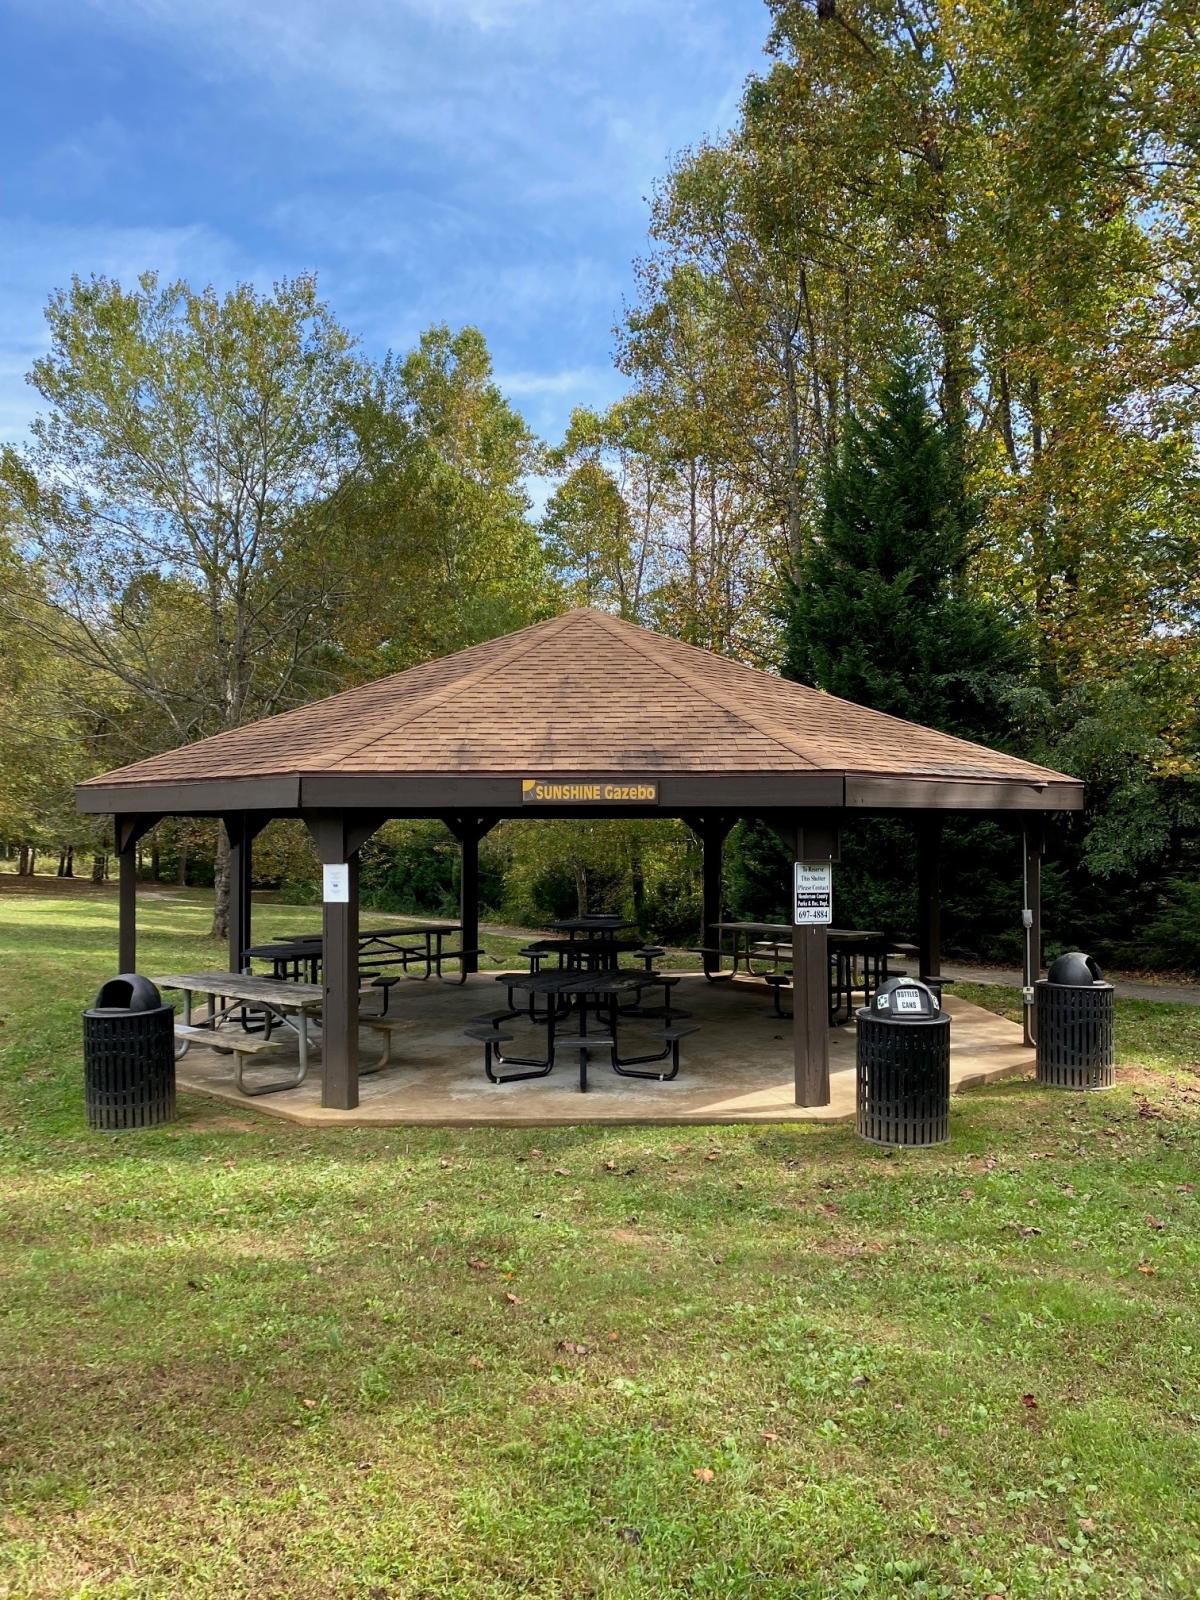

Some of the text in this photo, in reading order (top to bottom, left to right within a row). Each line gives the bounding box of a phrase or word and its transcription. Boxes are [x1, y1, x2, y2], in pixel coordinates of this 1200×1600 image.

[536, 785, 655, 800] SUNSHINE Gazebo
[798, 910, 828, 919] 697-4884
